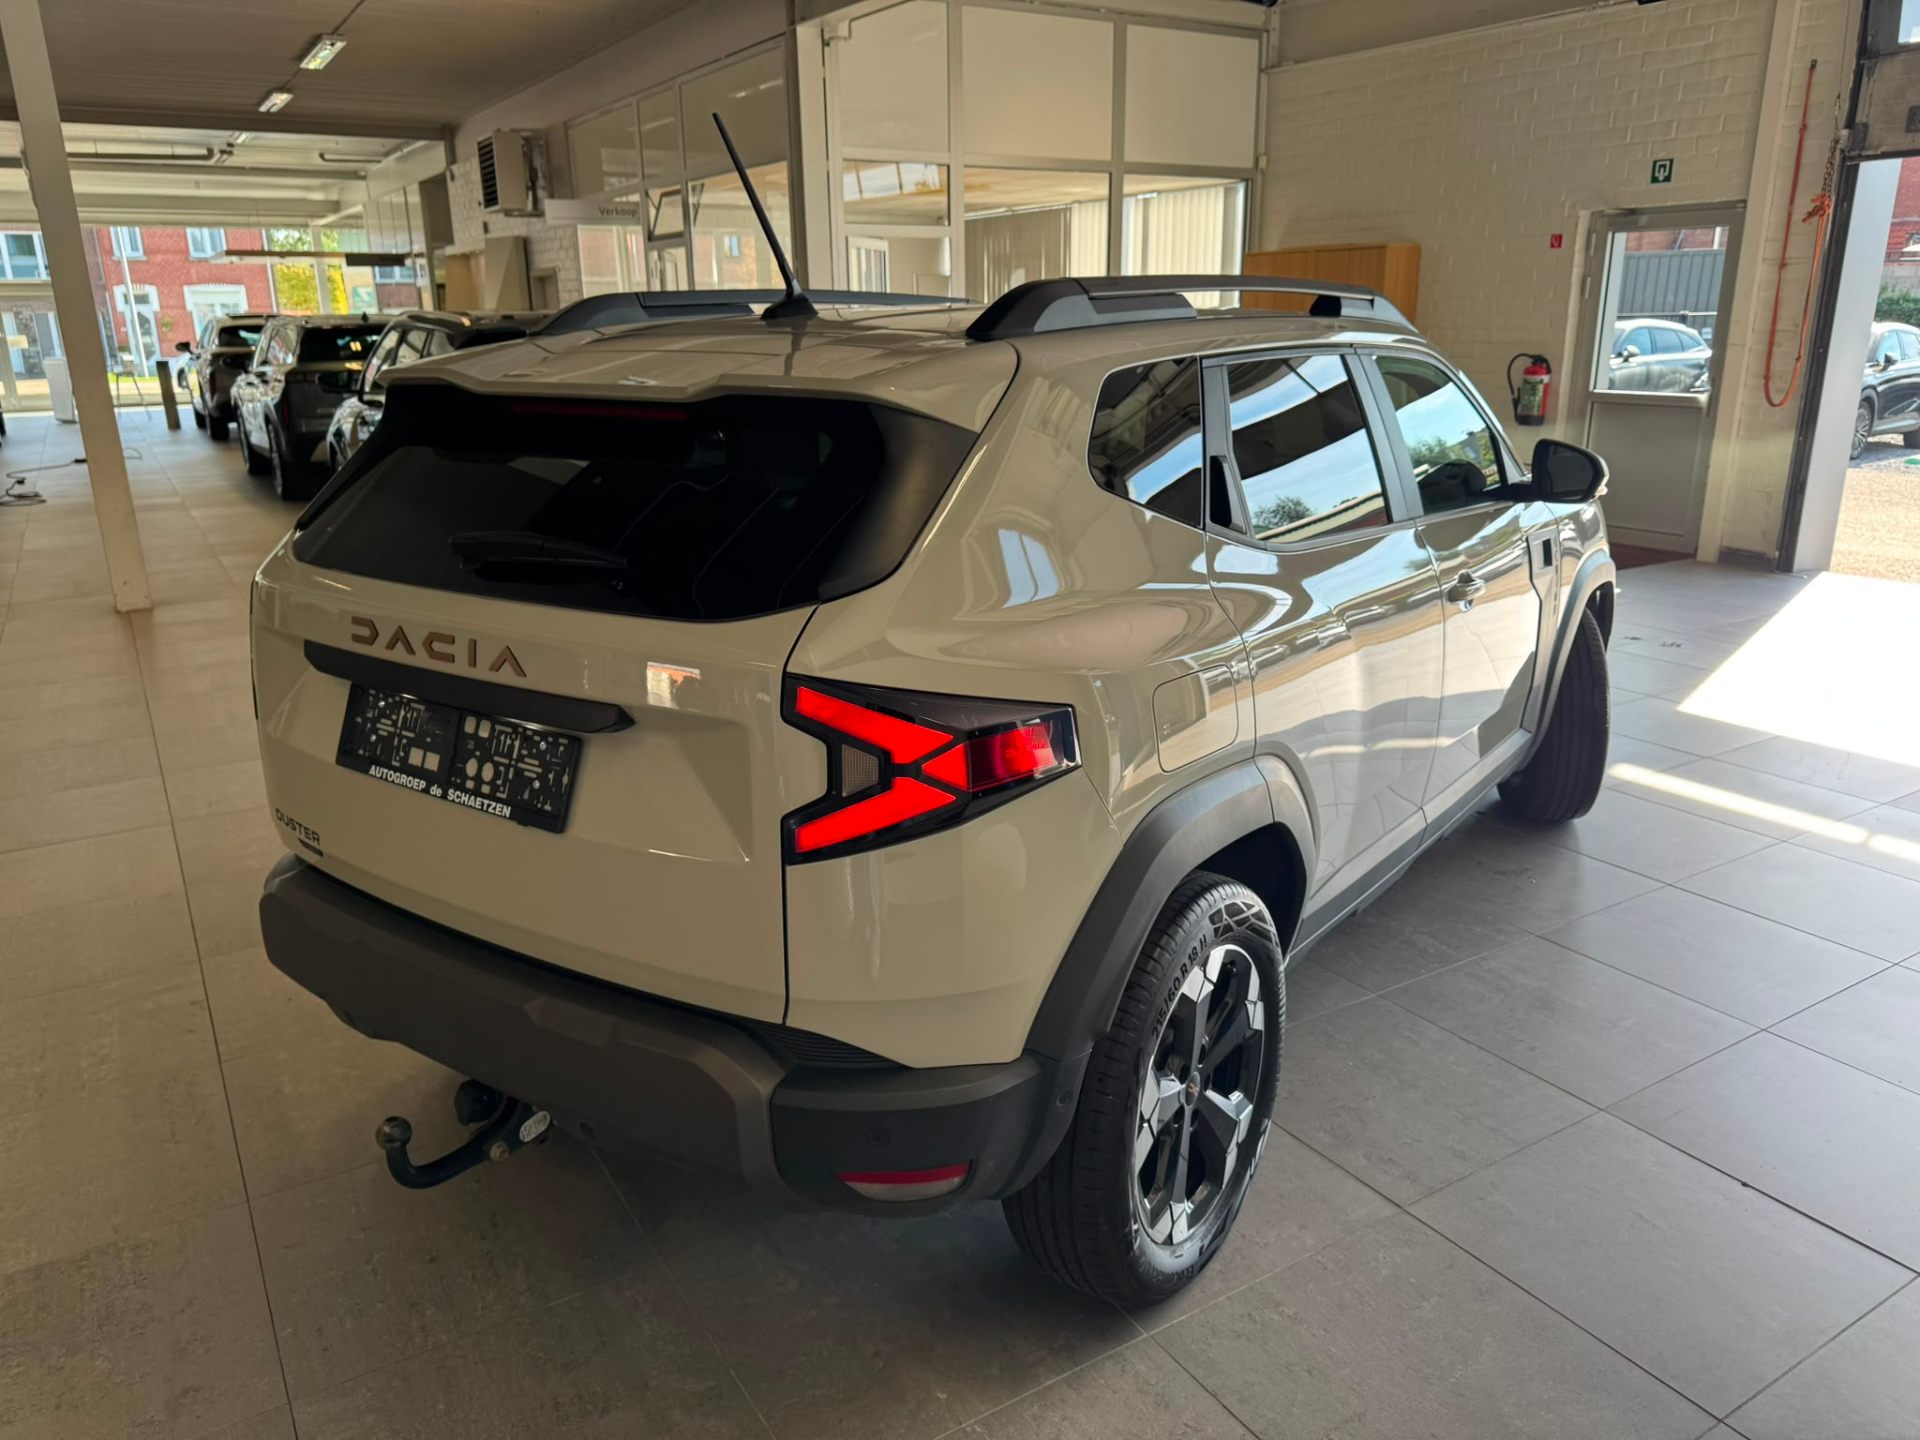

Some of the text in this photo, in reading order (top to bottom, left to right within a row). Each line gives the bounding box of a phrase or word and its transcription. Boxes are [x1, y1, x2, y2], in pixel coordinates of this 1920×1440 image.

[599, 207, 637, 217] Verkoop
[351, 616, 527, 677] DACIA
[368, 764, 511, 818] AUTOGROEP de SCHAETZEN
[1180, 962, 1189, 979] R
[1188, 946, 1199, 966] 18
